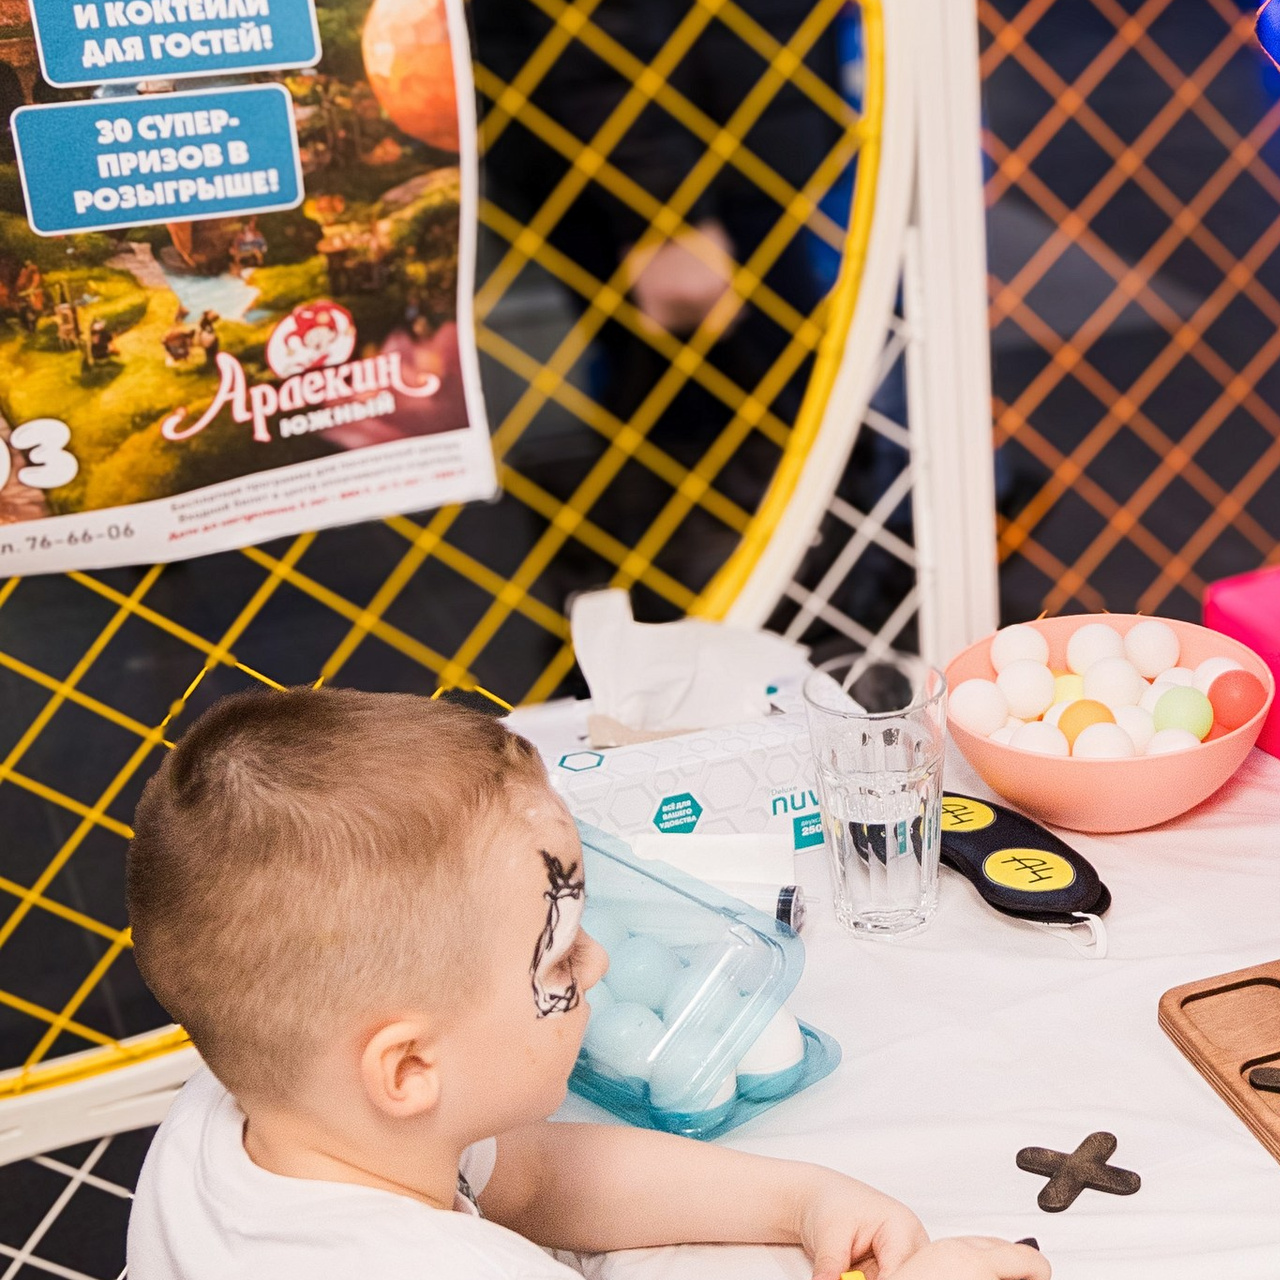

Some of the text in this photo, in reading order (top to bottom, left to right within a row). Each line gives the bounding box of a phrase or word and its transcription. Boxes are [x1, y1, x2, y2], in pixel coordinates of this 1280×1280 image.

[72, 3, 101, 30] И
[81, 21, 274, 69] ДЛЯ ГОСТЕЙ!
[95, 108, 241, 145] 30 СУПЕР-
[96, 140, 250, 179] ПРИЗОВ В
[73, 167, 280, 214] РОЗЫГРЫШЕ!
[161, 350, 441, 442] Арлекин
[279, 390, 396, 438] ЮЖНЫЙ
[25, 523, 136, 550] 76-66-06
